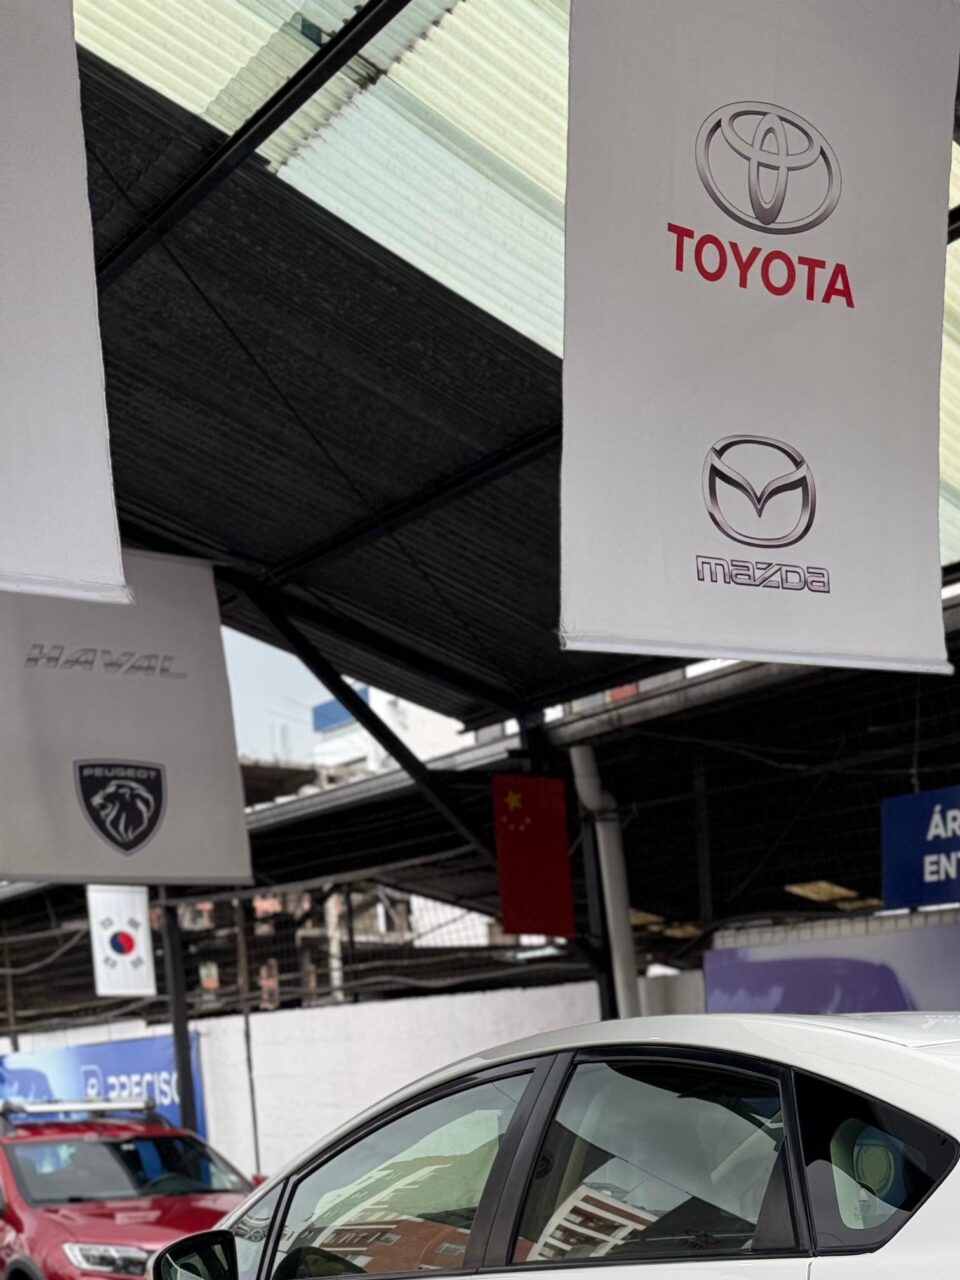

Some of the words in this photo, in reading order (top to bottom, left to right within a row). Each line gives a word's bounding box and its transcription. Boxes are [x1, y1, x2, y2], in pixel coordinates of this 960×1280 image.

[667, 222, 855, 309] TOYOTA
[25, 643, 188, 680] HAVAL
[82, 767, 157, 779] PEUGEOT
